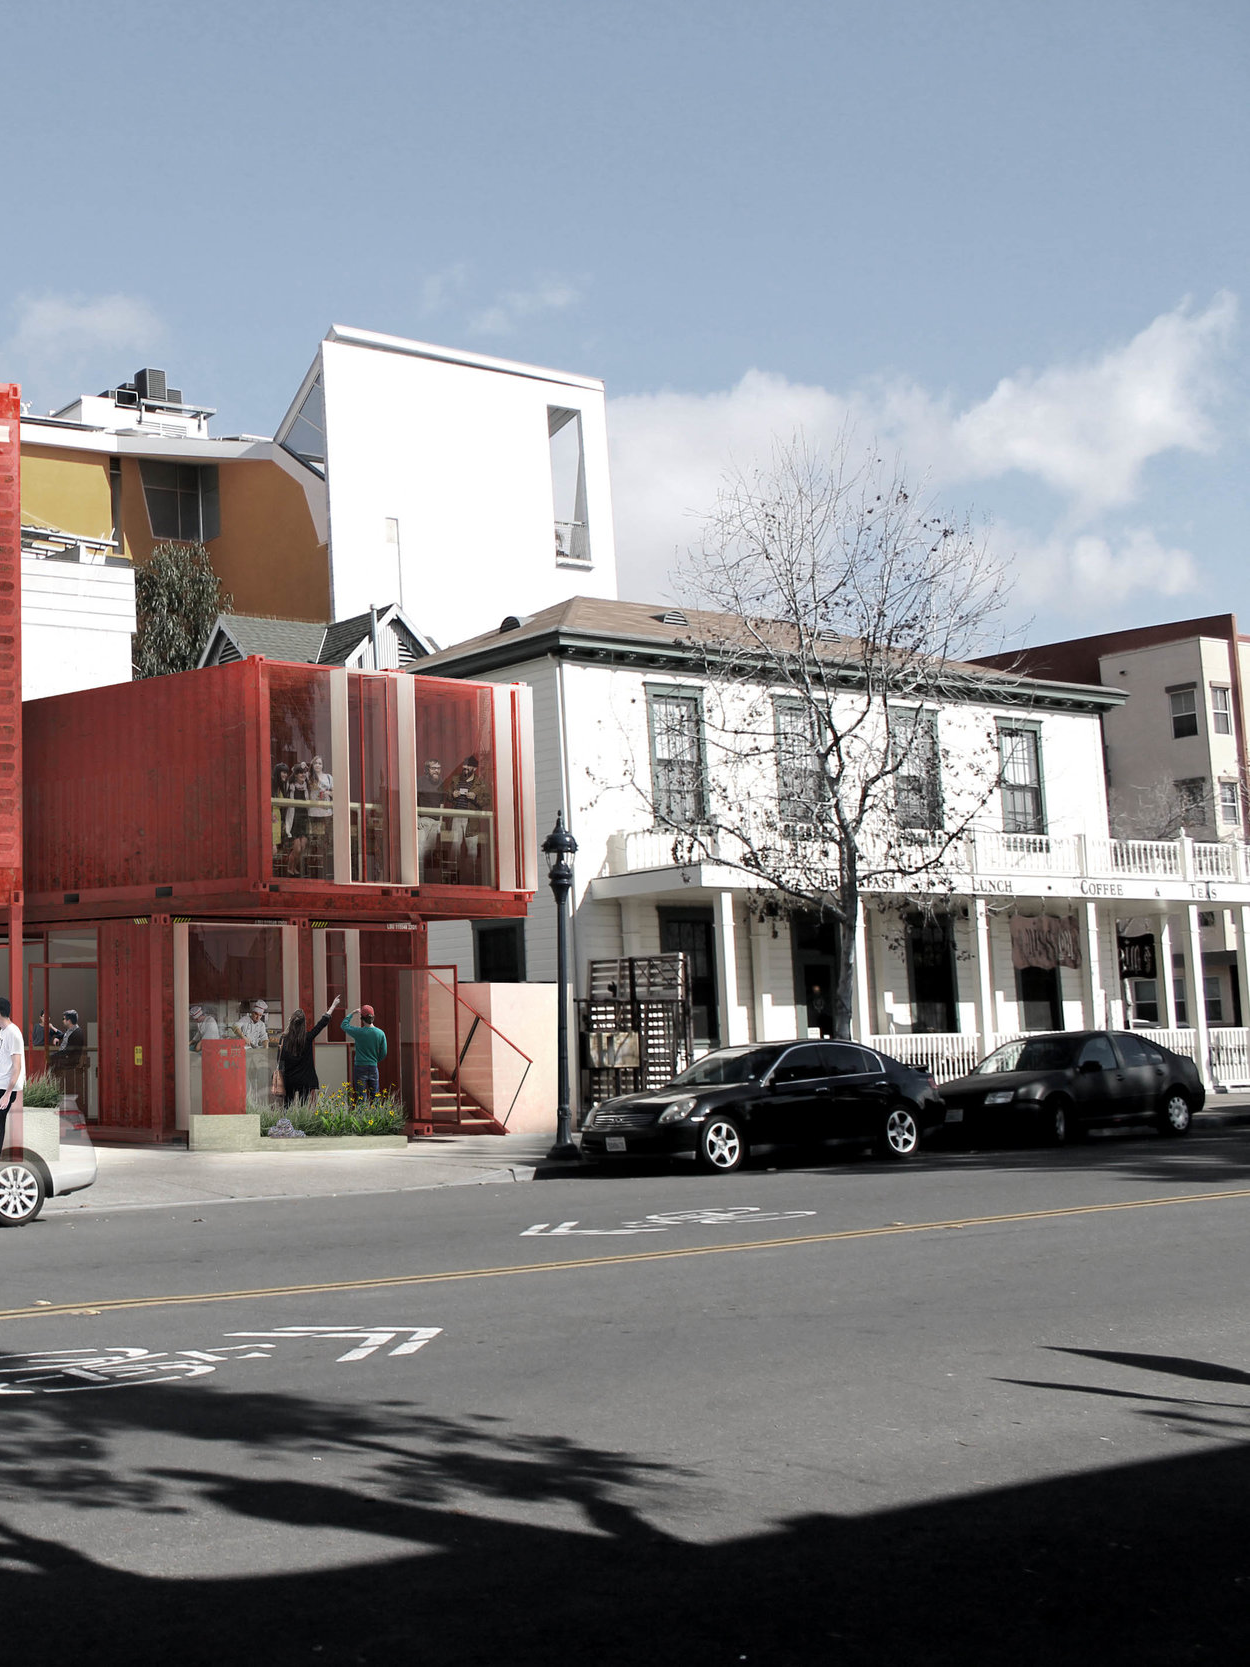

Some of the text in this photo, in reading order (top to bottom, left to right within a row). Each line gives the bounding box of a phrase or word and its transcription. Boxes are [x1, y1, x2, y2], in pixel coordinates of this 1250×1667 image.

[820, 870, 897, 889] BRFAST
[971, 876, 1013, 893] LUNCH
[1080, 880, 1124, 896] COFFEE
